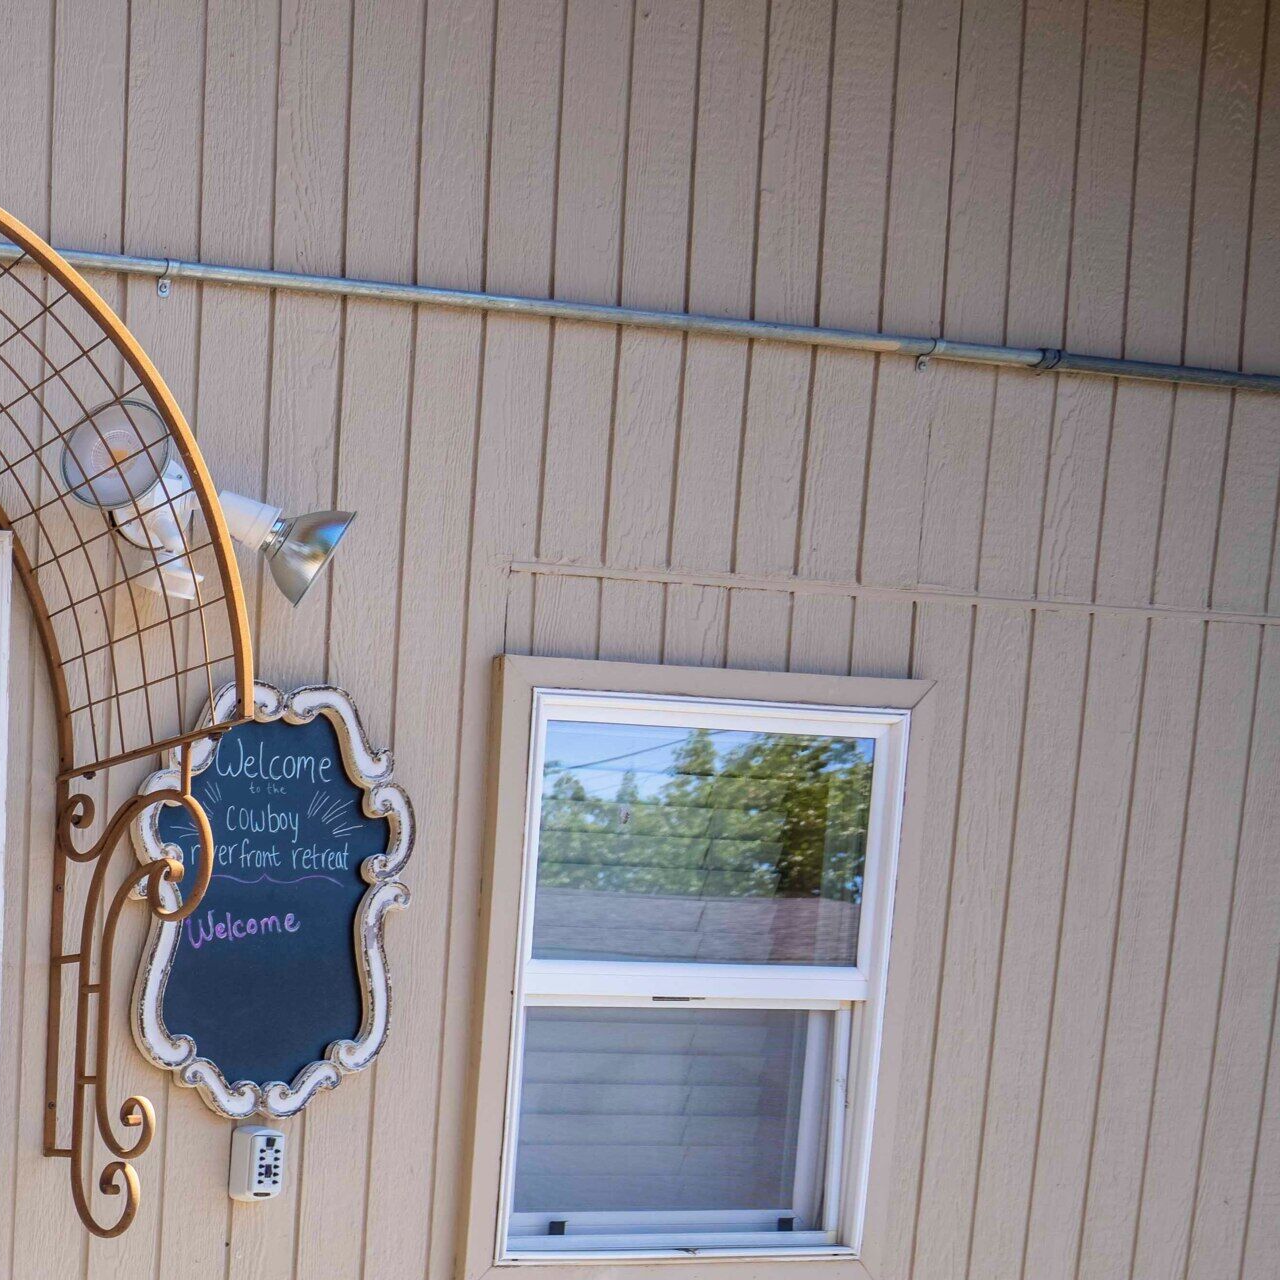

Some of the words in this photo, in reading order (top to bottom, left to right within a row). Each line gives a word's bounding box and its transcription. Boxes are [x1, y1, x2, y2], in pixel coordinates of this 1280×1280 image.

[216, 737, 332, 783] Welcome
[249, 781, 261, 794] to
[267, 782, 288, 795] the
[292, 843, 349, 870] retreat
[185, 909, 301, 949] Welcome
